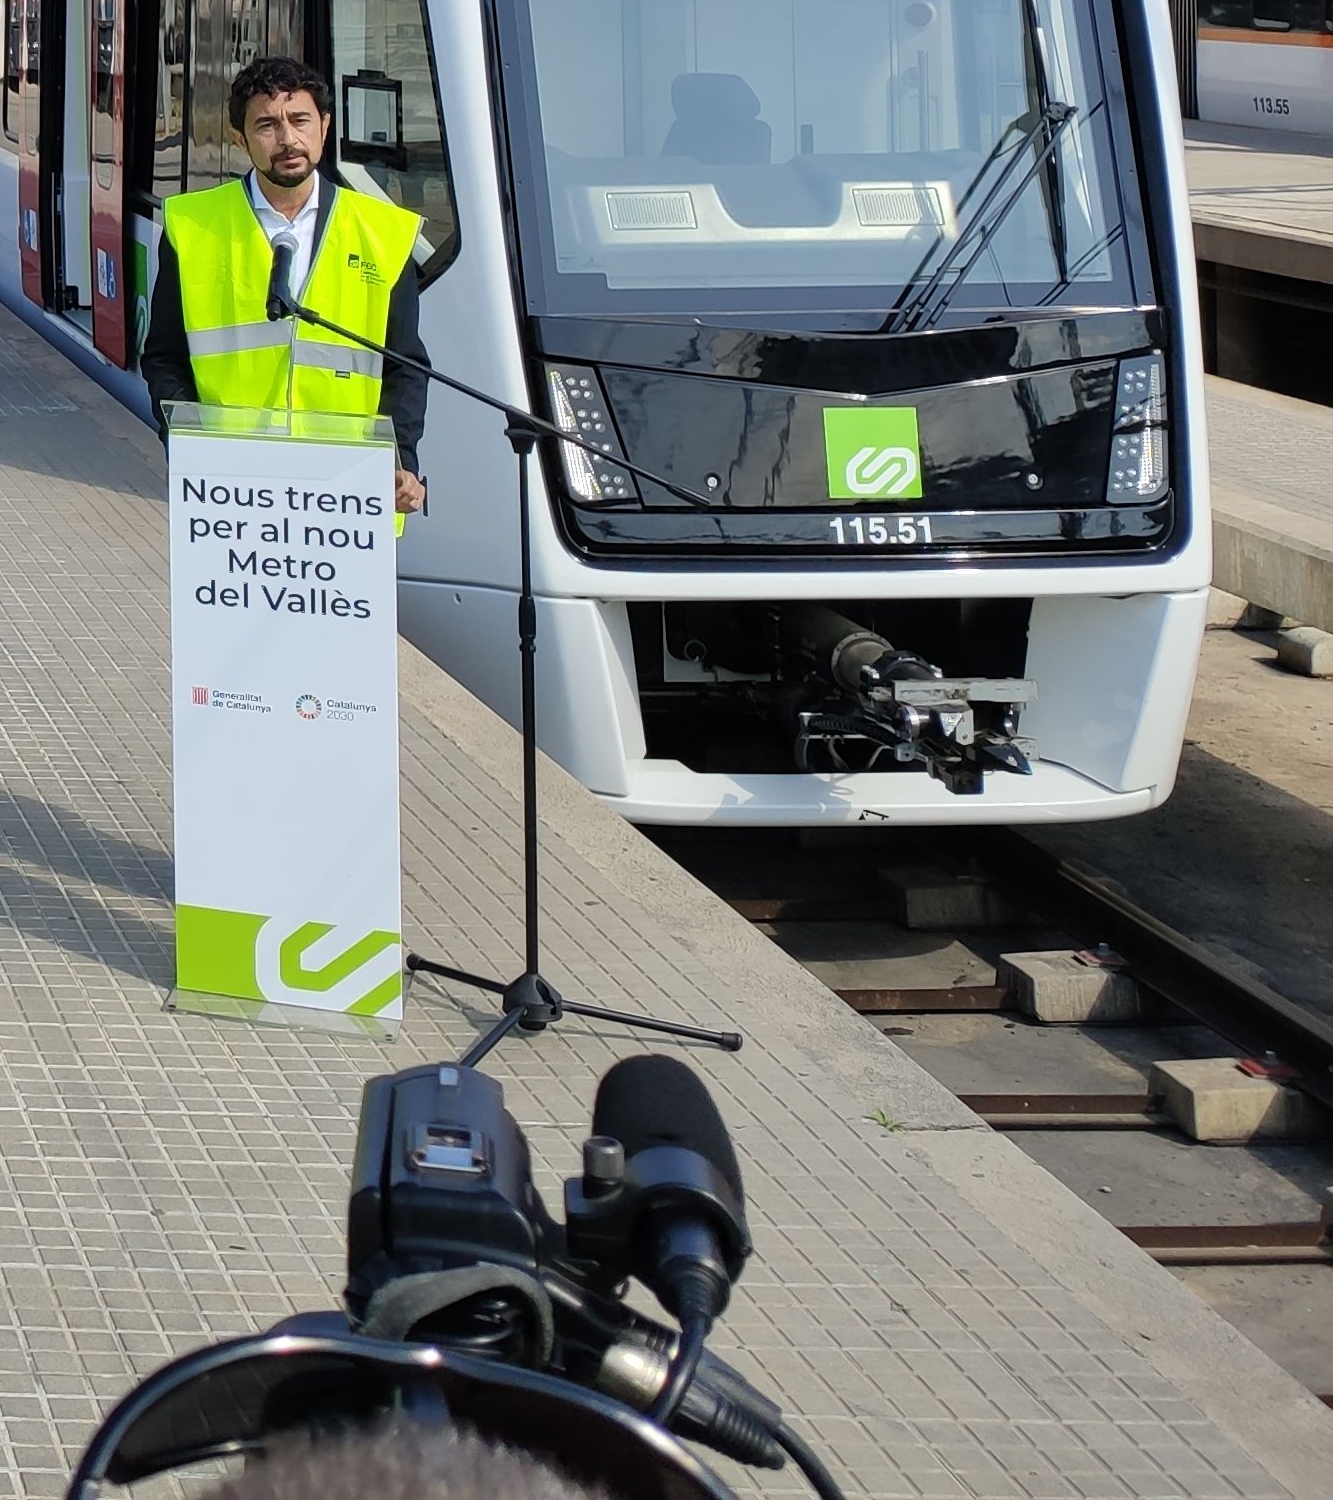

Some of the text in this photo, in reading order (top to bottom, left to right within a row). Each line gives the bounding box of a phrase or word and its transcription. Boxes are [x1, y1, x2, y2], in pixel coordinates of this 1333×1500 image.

[1253, 97, 1289, 115] 113.55
[183, 478, 383, 516] Nous trens
[190, 517, 374, 551] per al nou
[829, 516, 933, 544] 115.51
[229, 548, 335, 581] Metro
[195, 580, 371, 619] del Vallès
[212, 689, 262, 702] Generalitat
[212, 700, 272, 714] de Catalunya
[326, 699, 377, 713] Catalunya
[326, 710, 355, 722] 2030
